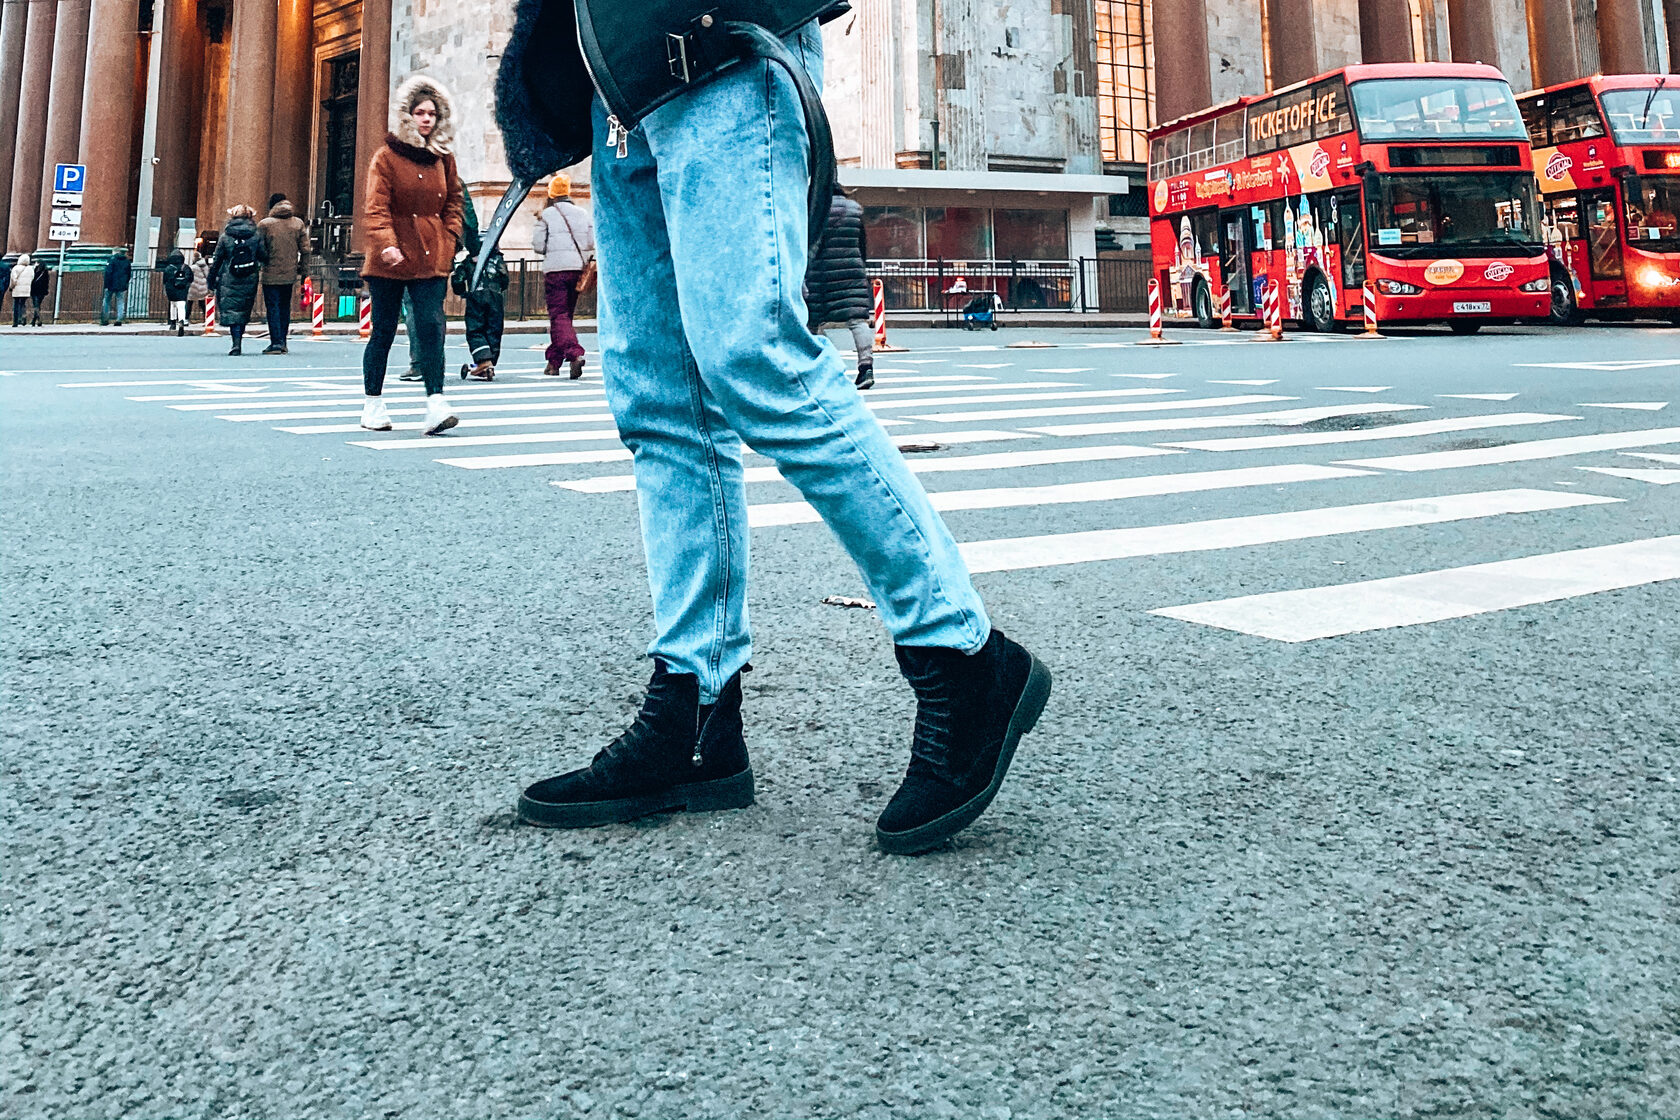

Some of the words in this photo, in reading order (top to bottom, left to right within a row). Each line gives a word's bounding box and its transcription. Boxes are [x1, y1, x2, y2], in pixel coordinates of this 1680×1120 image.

[1250, 92, 1336, 142] TICKETOFFICE
[63, 167, 80, 189] P
[1546, 159, 1571, 178] OFFICIAL
